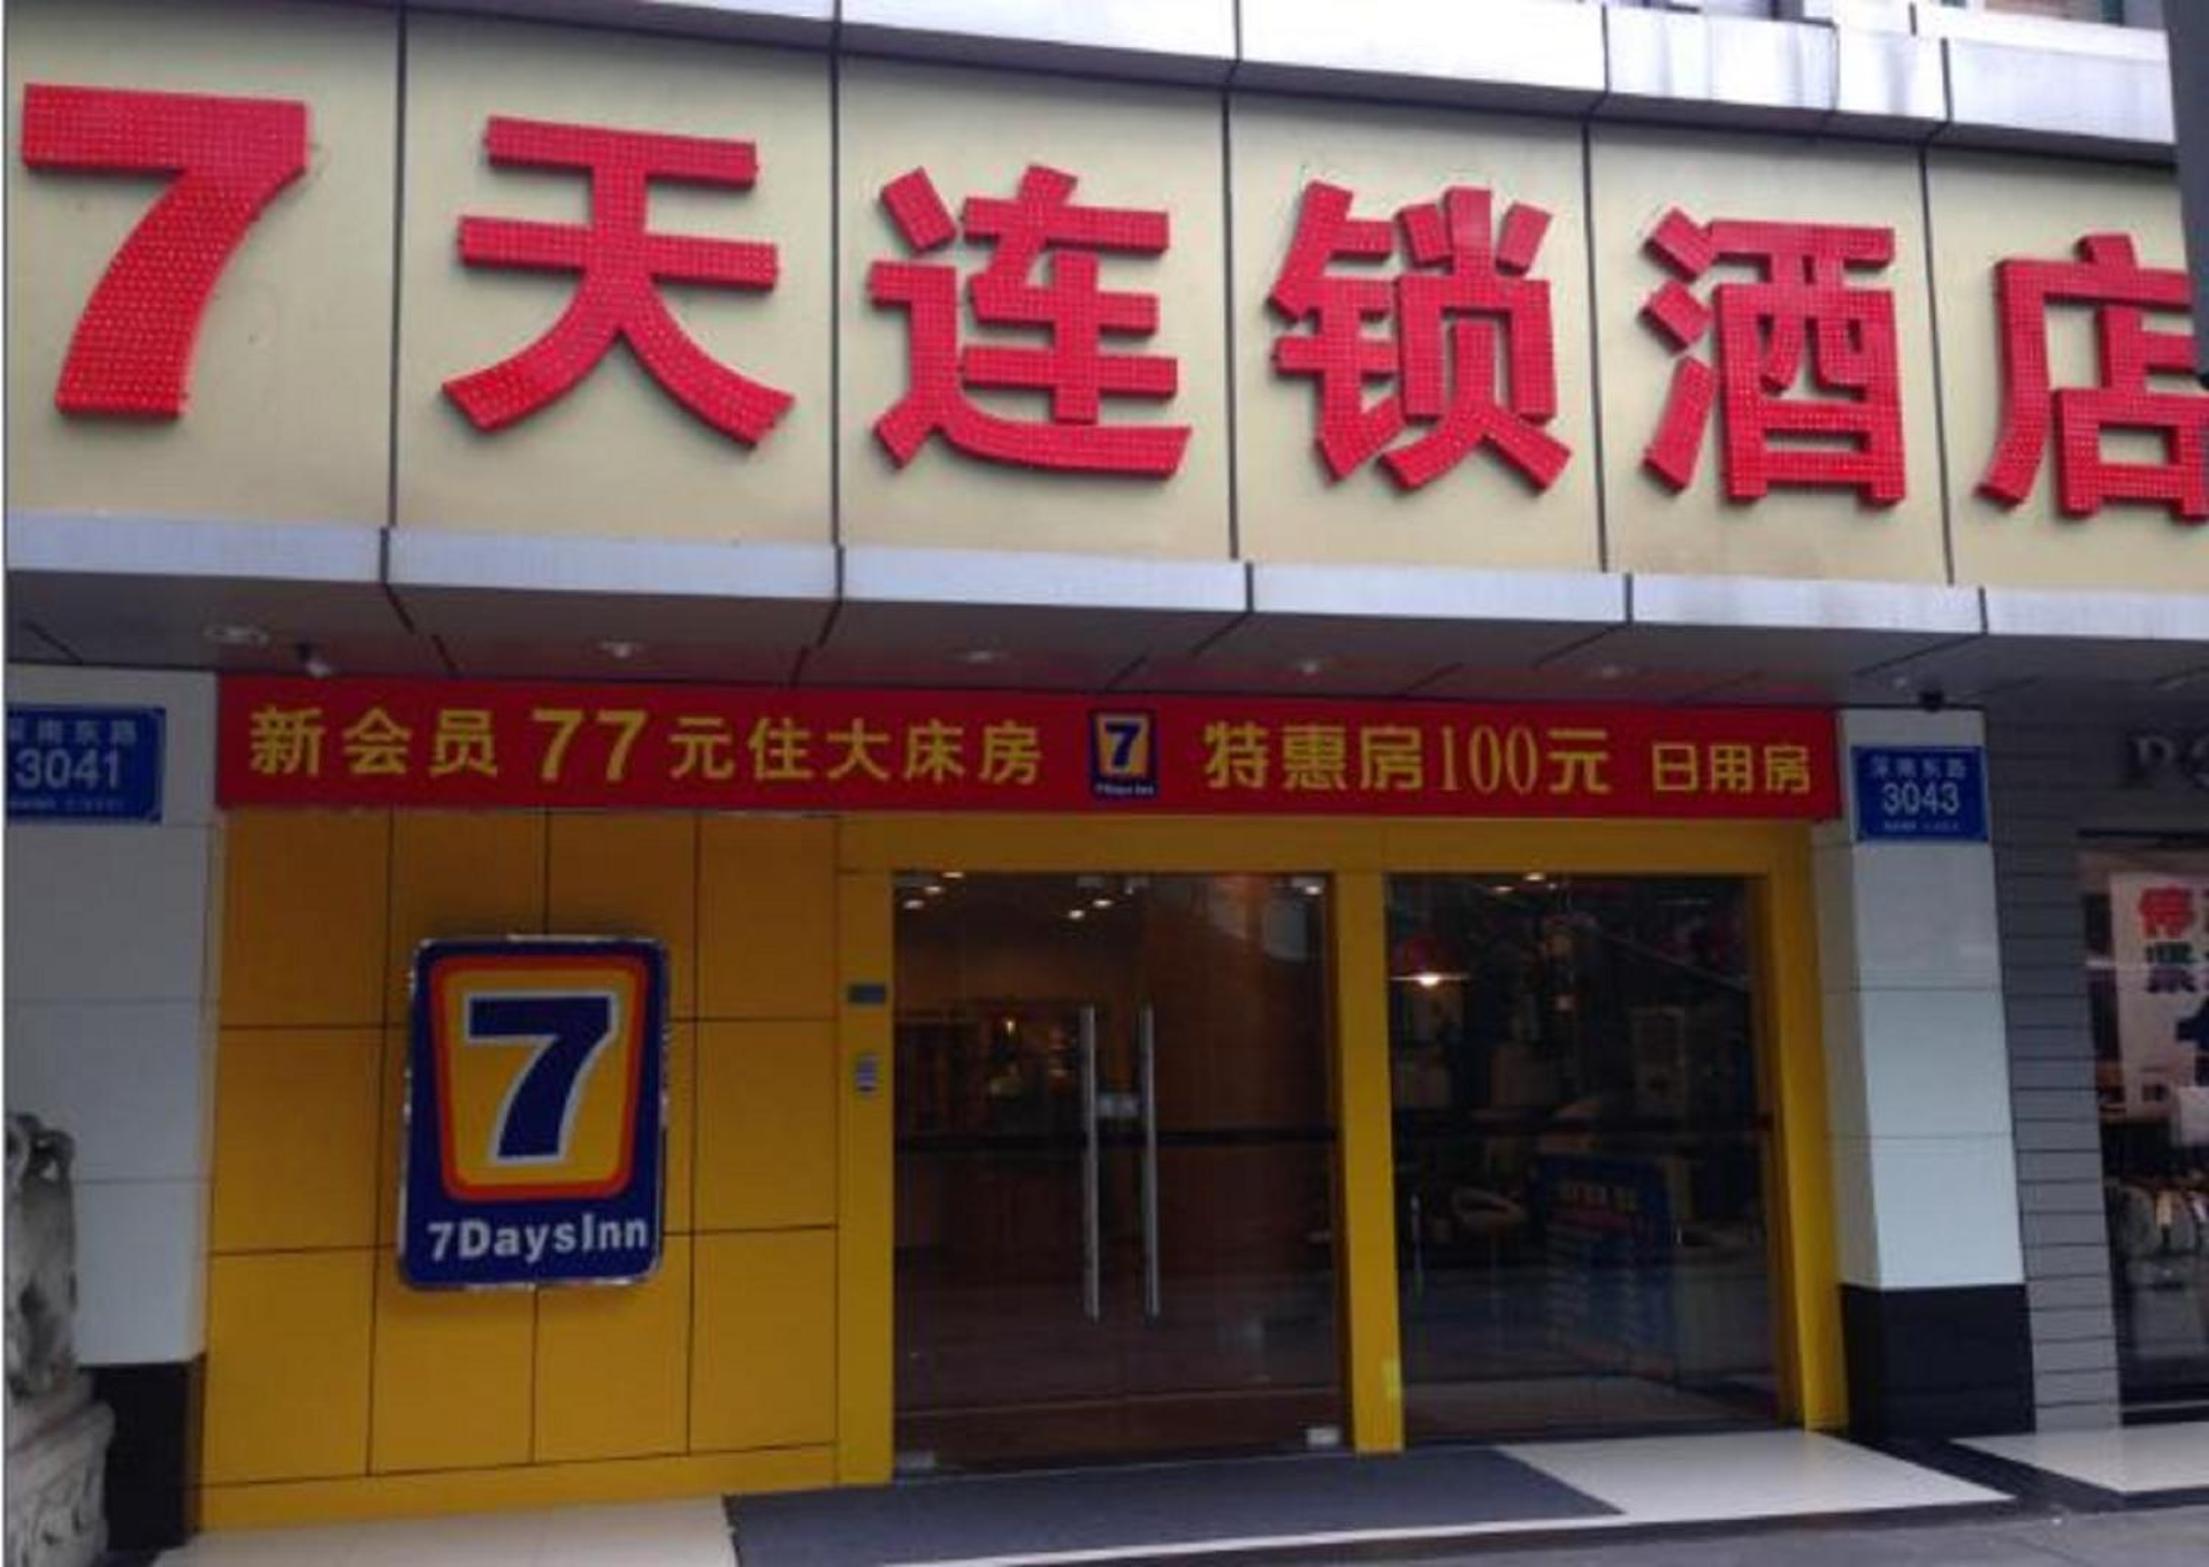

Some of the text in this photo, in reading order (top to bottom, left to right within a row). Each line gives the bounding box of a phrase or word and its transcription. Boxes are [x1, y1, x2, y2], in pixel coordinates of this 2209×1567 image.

[20, 83, 2209, 523] 7天连锁酒店
[14, 748, 119, 789] 3041
[1652, 743, 1812, 794] 日用房
[1882, 780, 1961, 815] 3043
[464, 990, 618, 1167] 7
